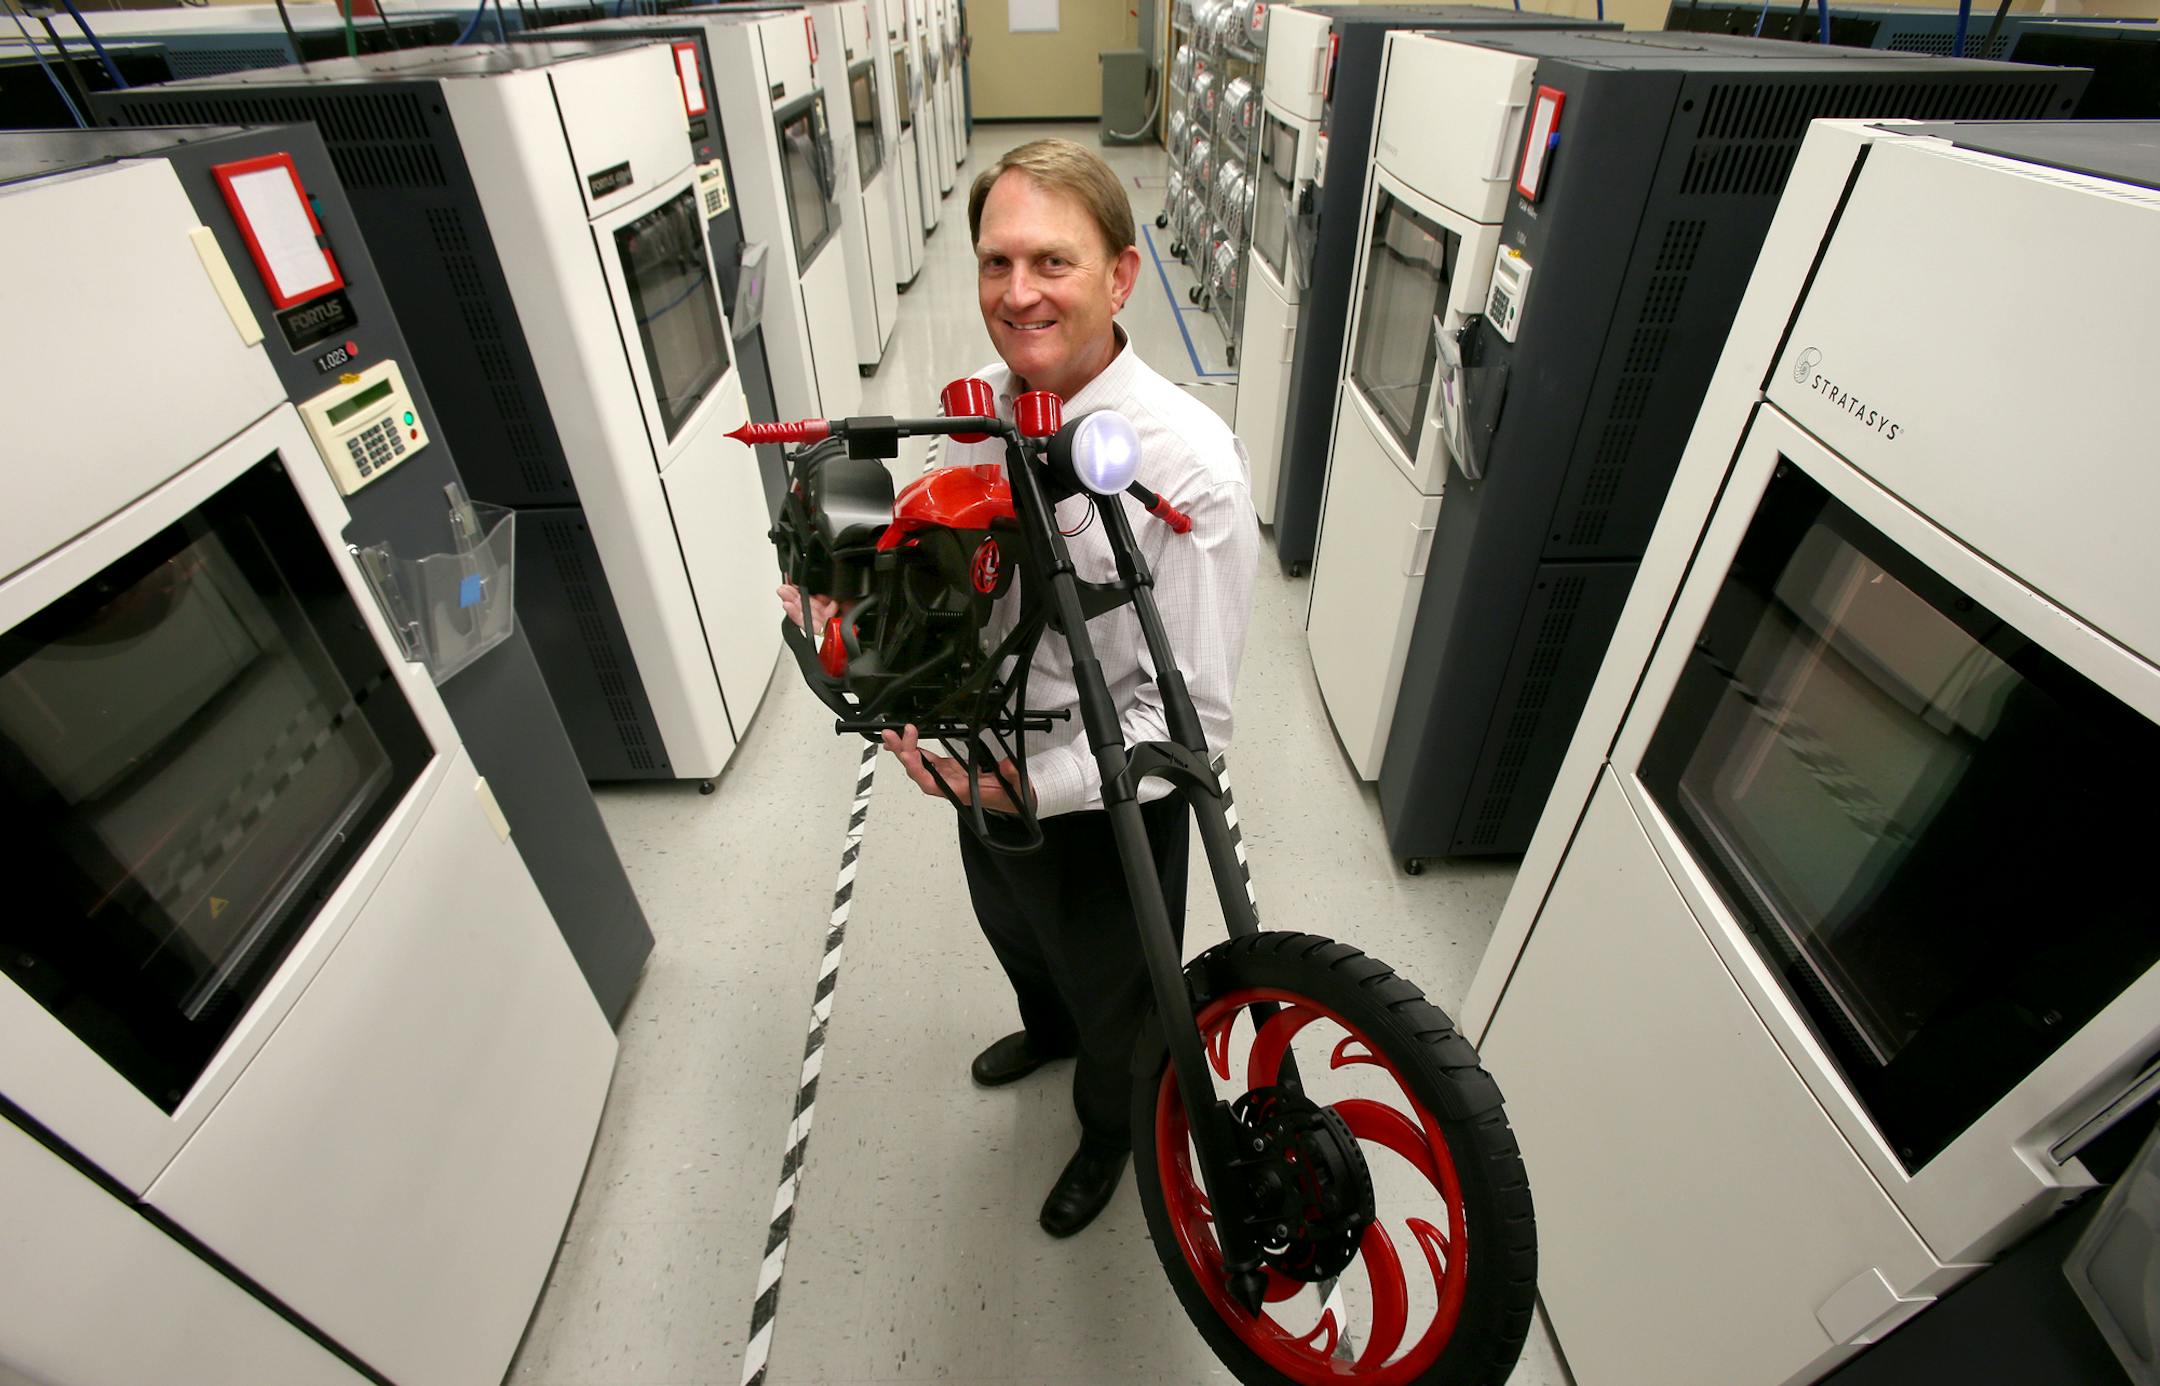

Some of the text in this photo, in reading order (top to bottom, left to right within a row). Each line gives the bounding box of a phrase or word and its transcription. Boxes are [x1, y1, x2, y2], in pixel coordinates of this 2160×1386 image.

[287, 299, 343, 332] FORTUS
[318, 348, 349, 371] 1.023
[1811, 374, 1900, 441] STRATASYS
